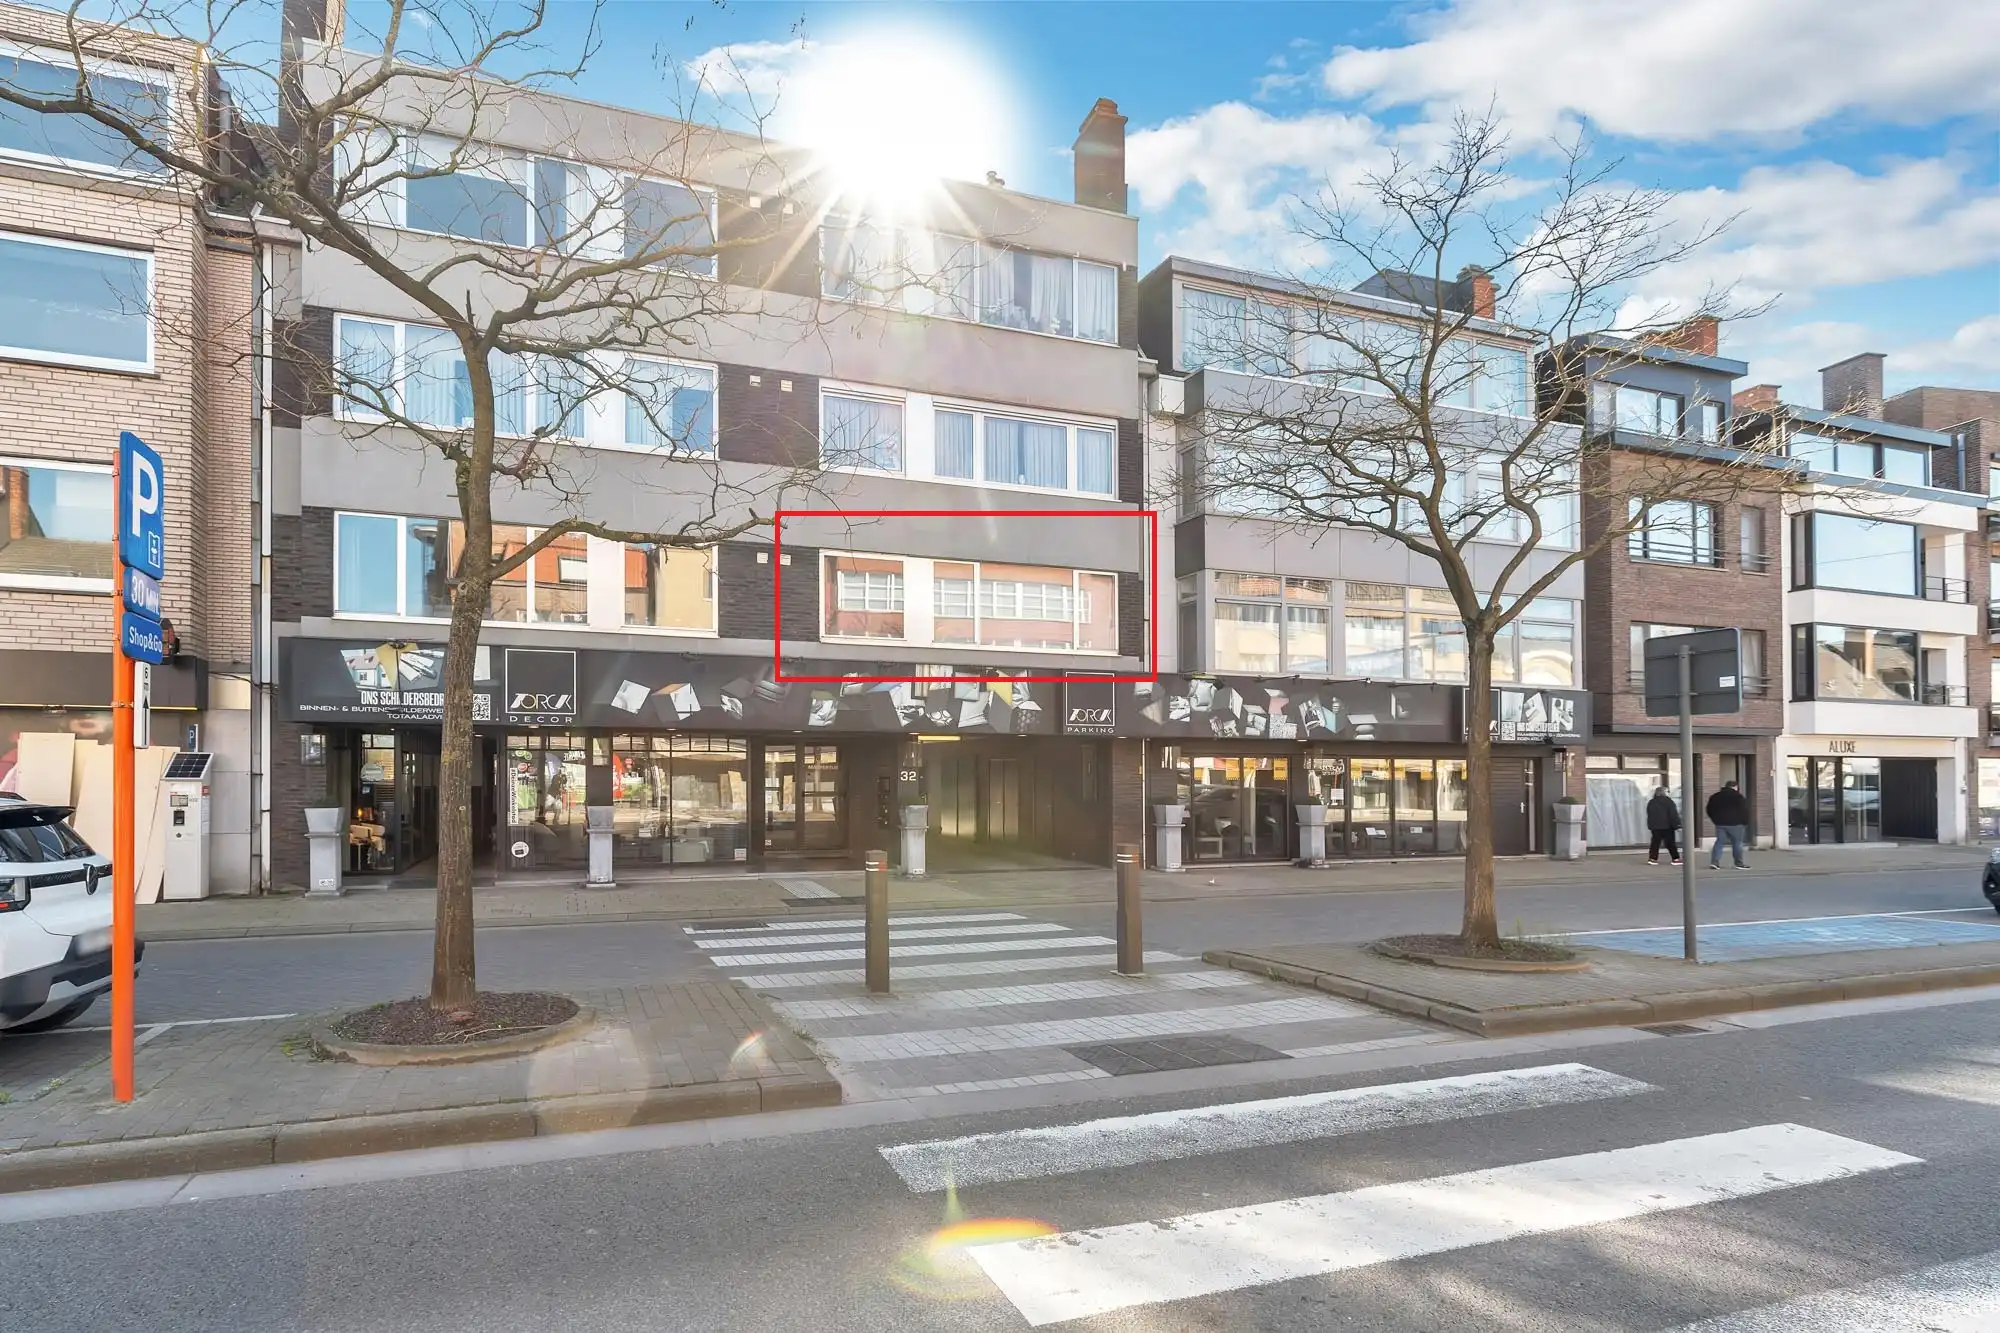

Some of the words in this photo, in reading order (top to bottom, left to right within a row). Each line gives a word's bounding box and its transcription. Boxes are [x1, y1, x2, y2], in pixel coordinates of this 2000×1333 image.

[132, 450, 158, 537] P
[131, 575, 144, 607] 30
[129, 626, 163, 653] Shop&Go
[144, 667, 149, 679] 6
[361, 690, 378, 705] ONS
[380, 691, 445, 706] SCHIDERSBEDR
[510, 693, 572, 710] TORCK
[509, 715, 572, 723] DECOR
[1069, 708, 1112, 722] TORCK
[1828, 740, 1857, 753] ALUXE
[900, 771, 917, 781] 32
